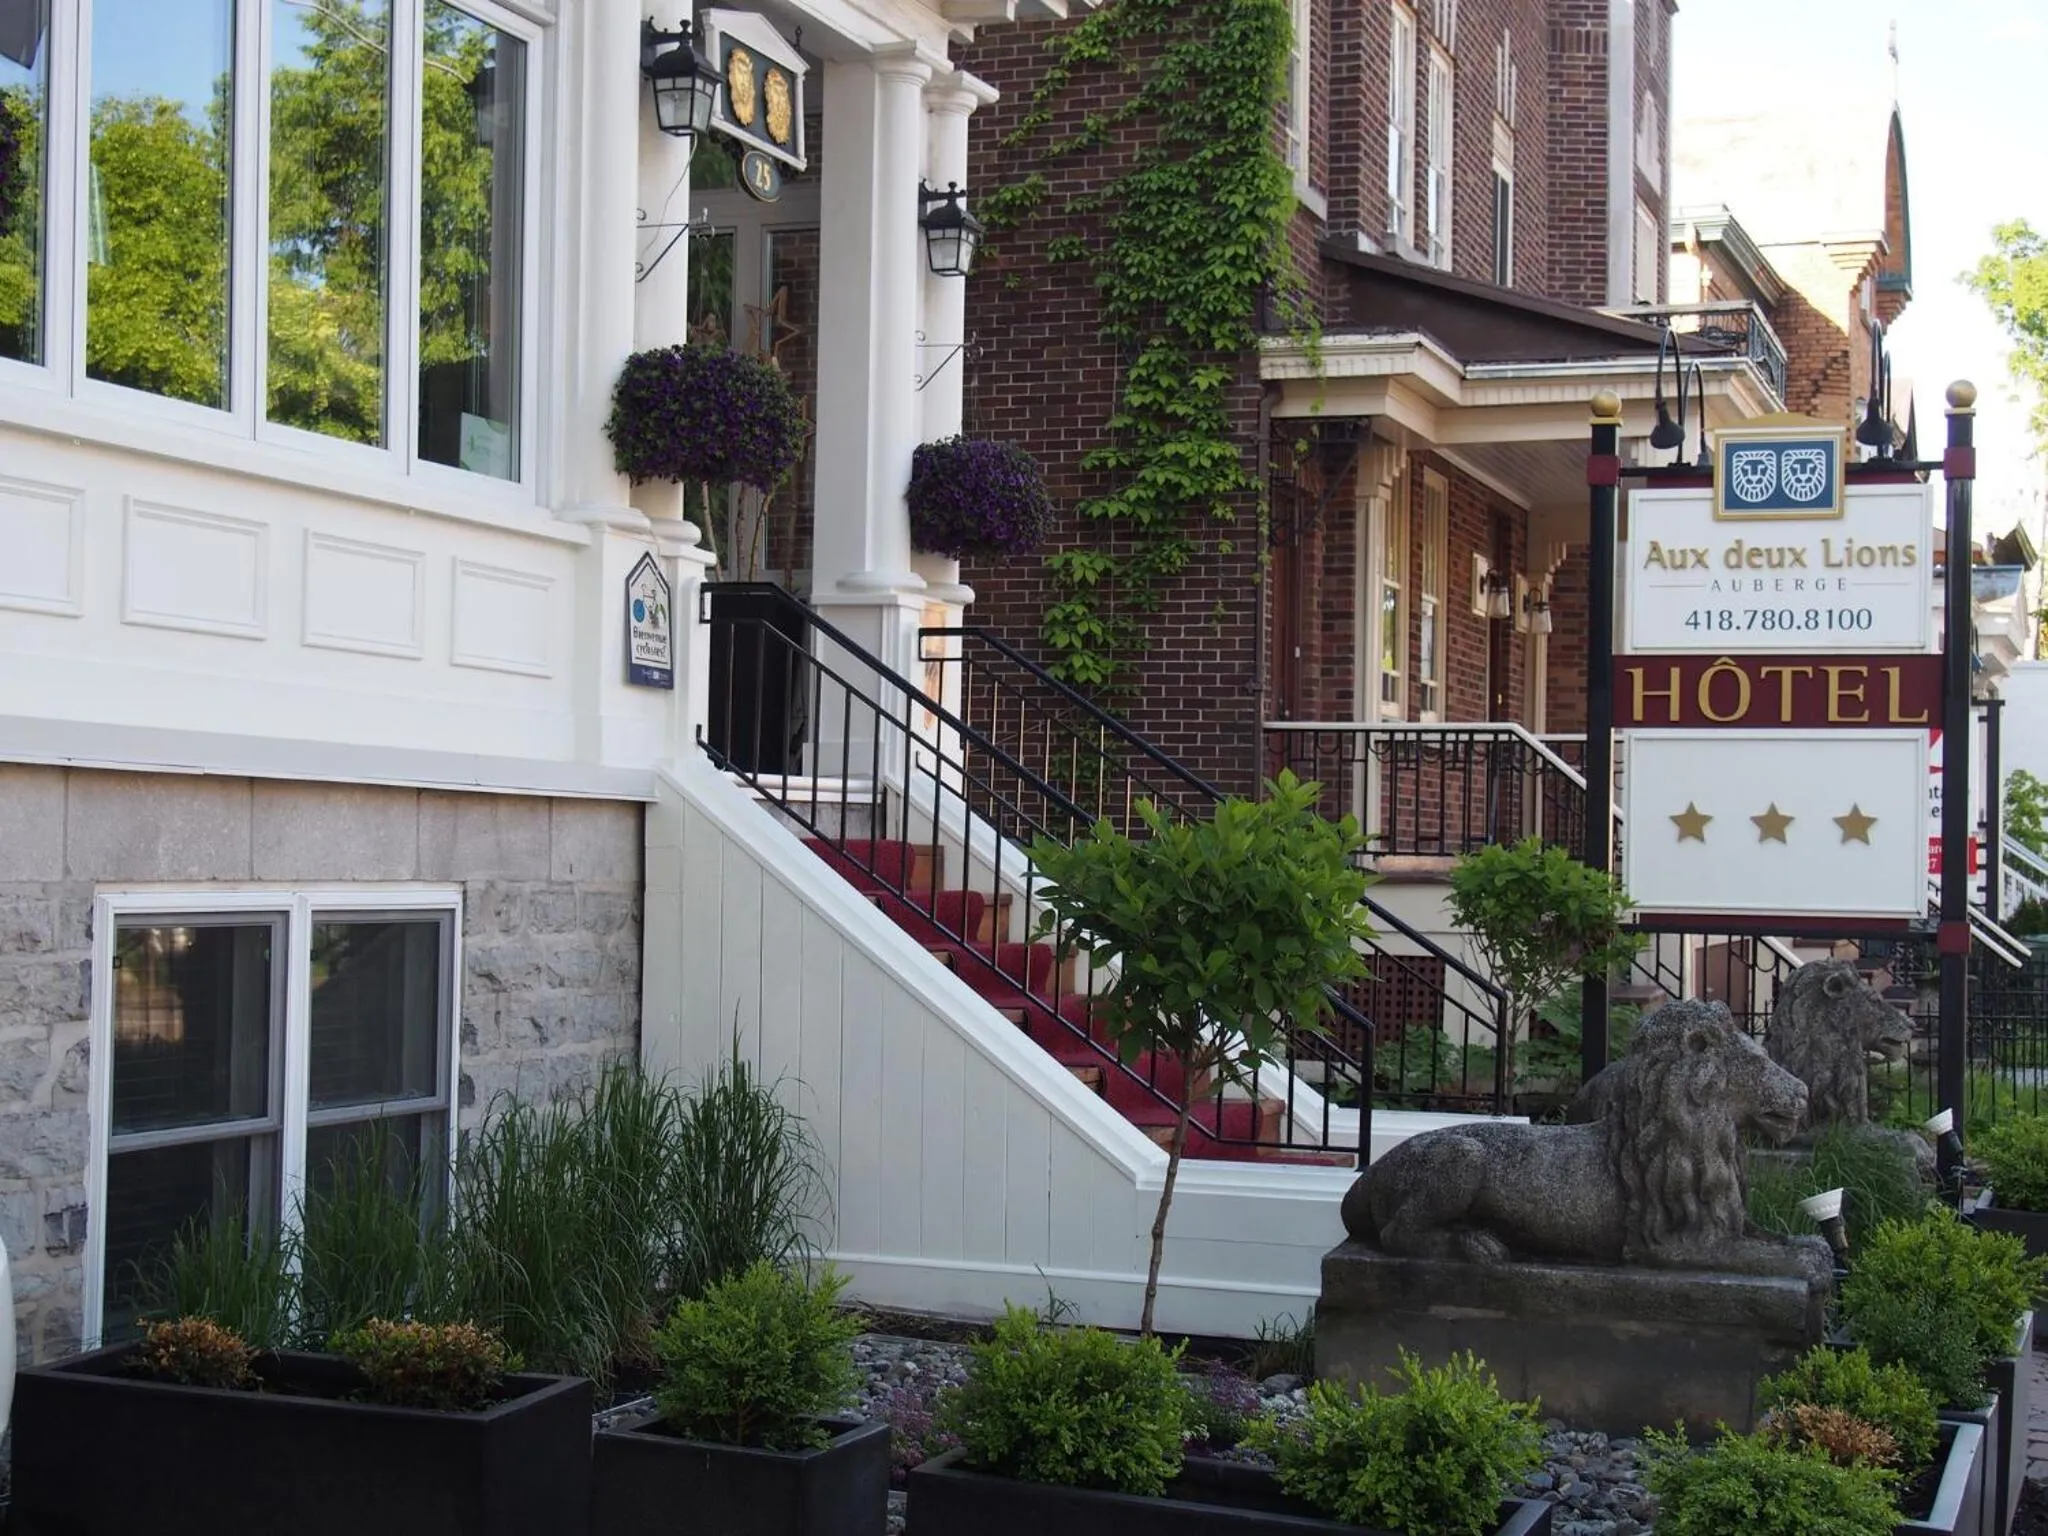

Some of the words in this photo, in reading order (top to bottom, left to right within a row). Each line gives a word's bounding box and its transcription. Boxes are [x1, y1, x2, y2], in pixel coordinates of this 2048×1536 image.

[755, 160, 772, 191] 25
[1643, 540, 1711, 570] Aux
[1723, 539, 1808, 570] deux
[1820, 538, 1918, 568] Lions
[1710, 578, 1847, 592] AUBERGE
[1684, 608, 1873, 631] 418.780.8100
[1624, 656, 1929, 723] HÔTEL
